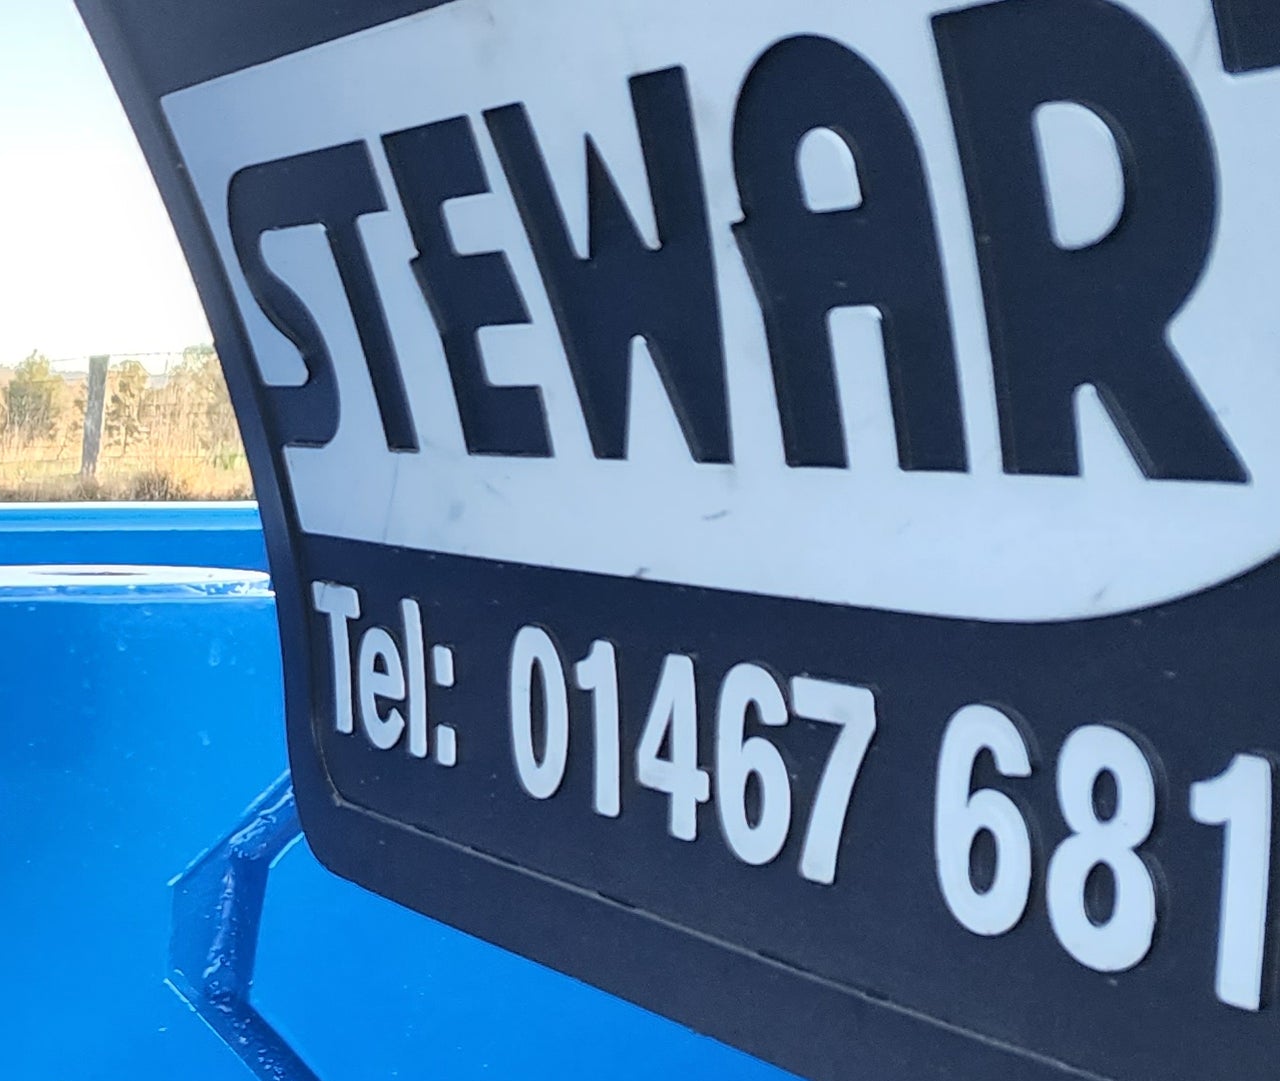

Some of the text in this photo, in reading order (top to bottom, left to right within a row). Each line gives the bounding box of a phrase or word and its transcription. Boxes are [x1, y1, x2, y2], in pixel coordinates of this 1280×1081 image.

[227, 0, 1280, 483] STEWAR
[311, 580, 1272, 1012] Tel: 01467 681
